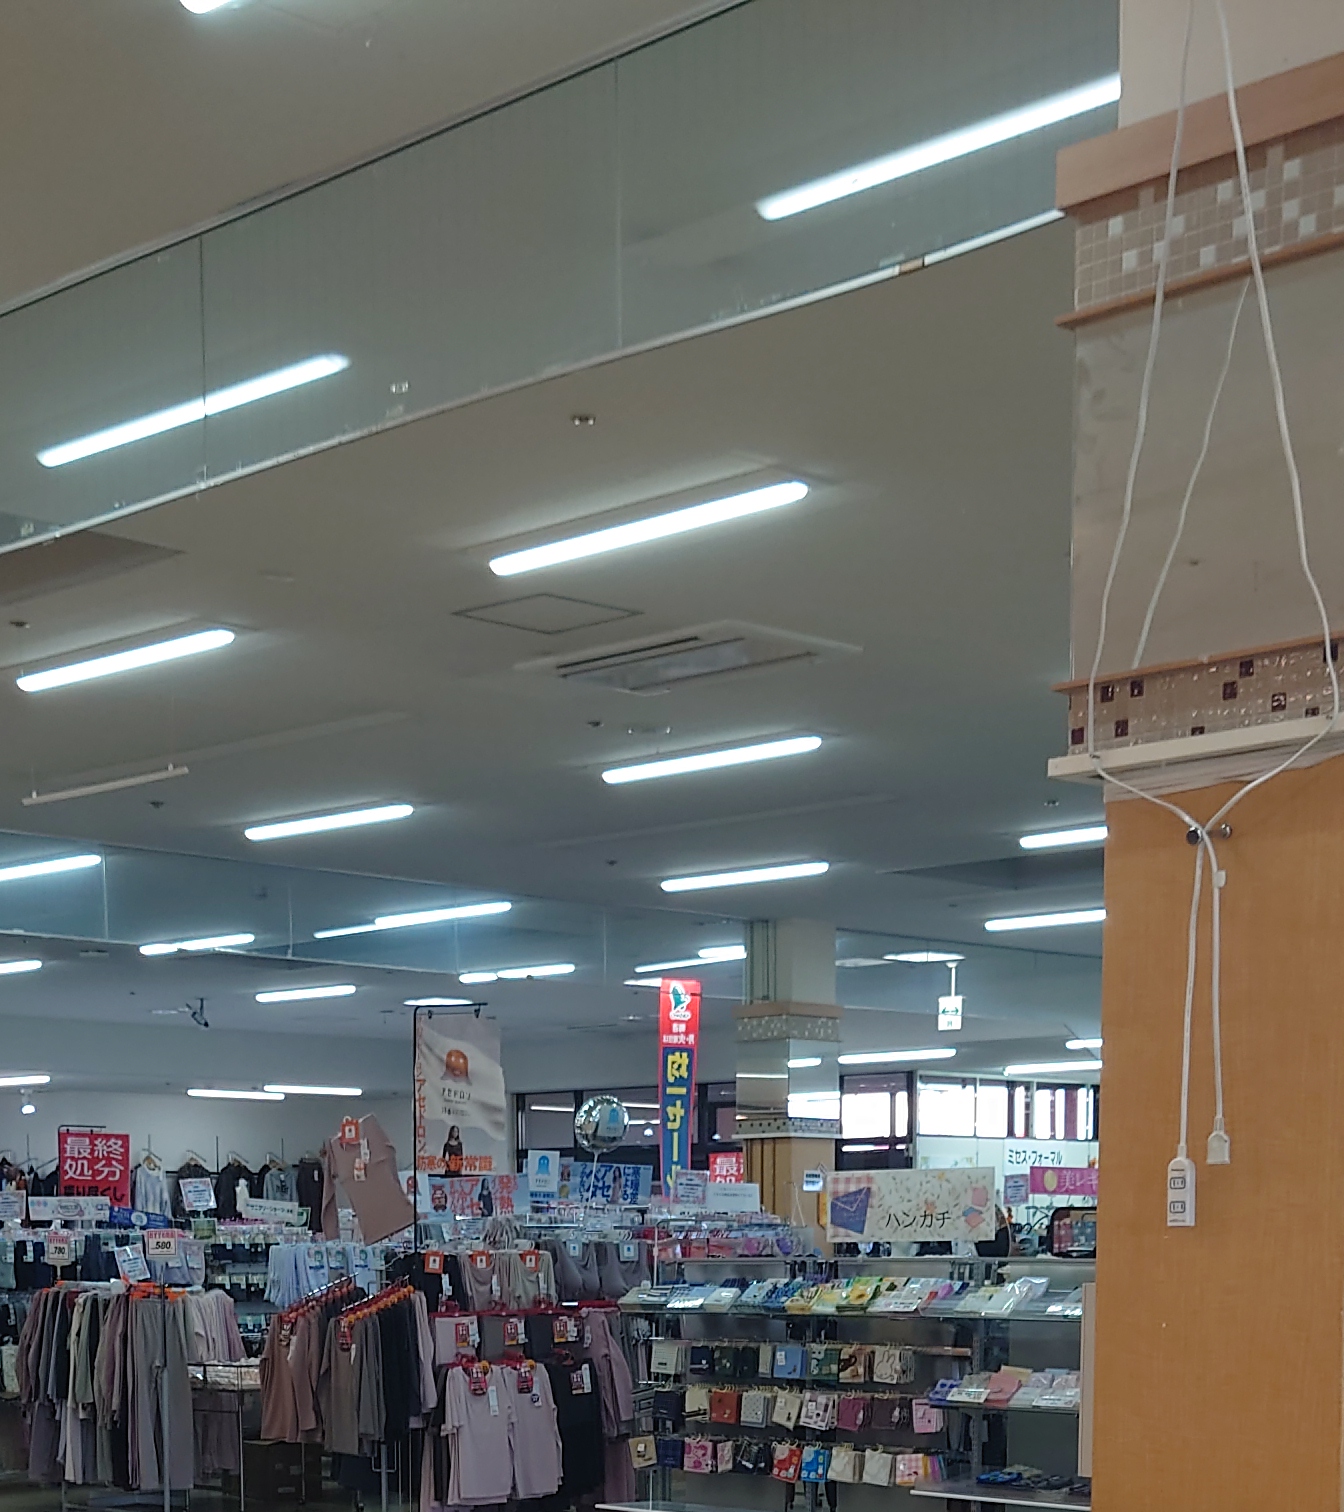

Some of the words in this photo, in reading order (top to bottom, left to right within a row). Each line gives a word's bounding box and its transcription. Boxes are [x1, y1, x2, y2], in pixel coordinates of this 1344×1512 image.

[64, 1137, 125, 1159] 最終
[1008, 1150, 1063, 1166] ミセス・フォーマル
[64, 1160, 125, 1181] 処分
[885, 1210, 951, 1229] ハンカチ
[53, 1246, 66, 1255] 780
[155, 1241, 171, 1250] 580
